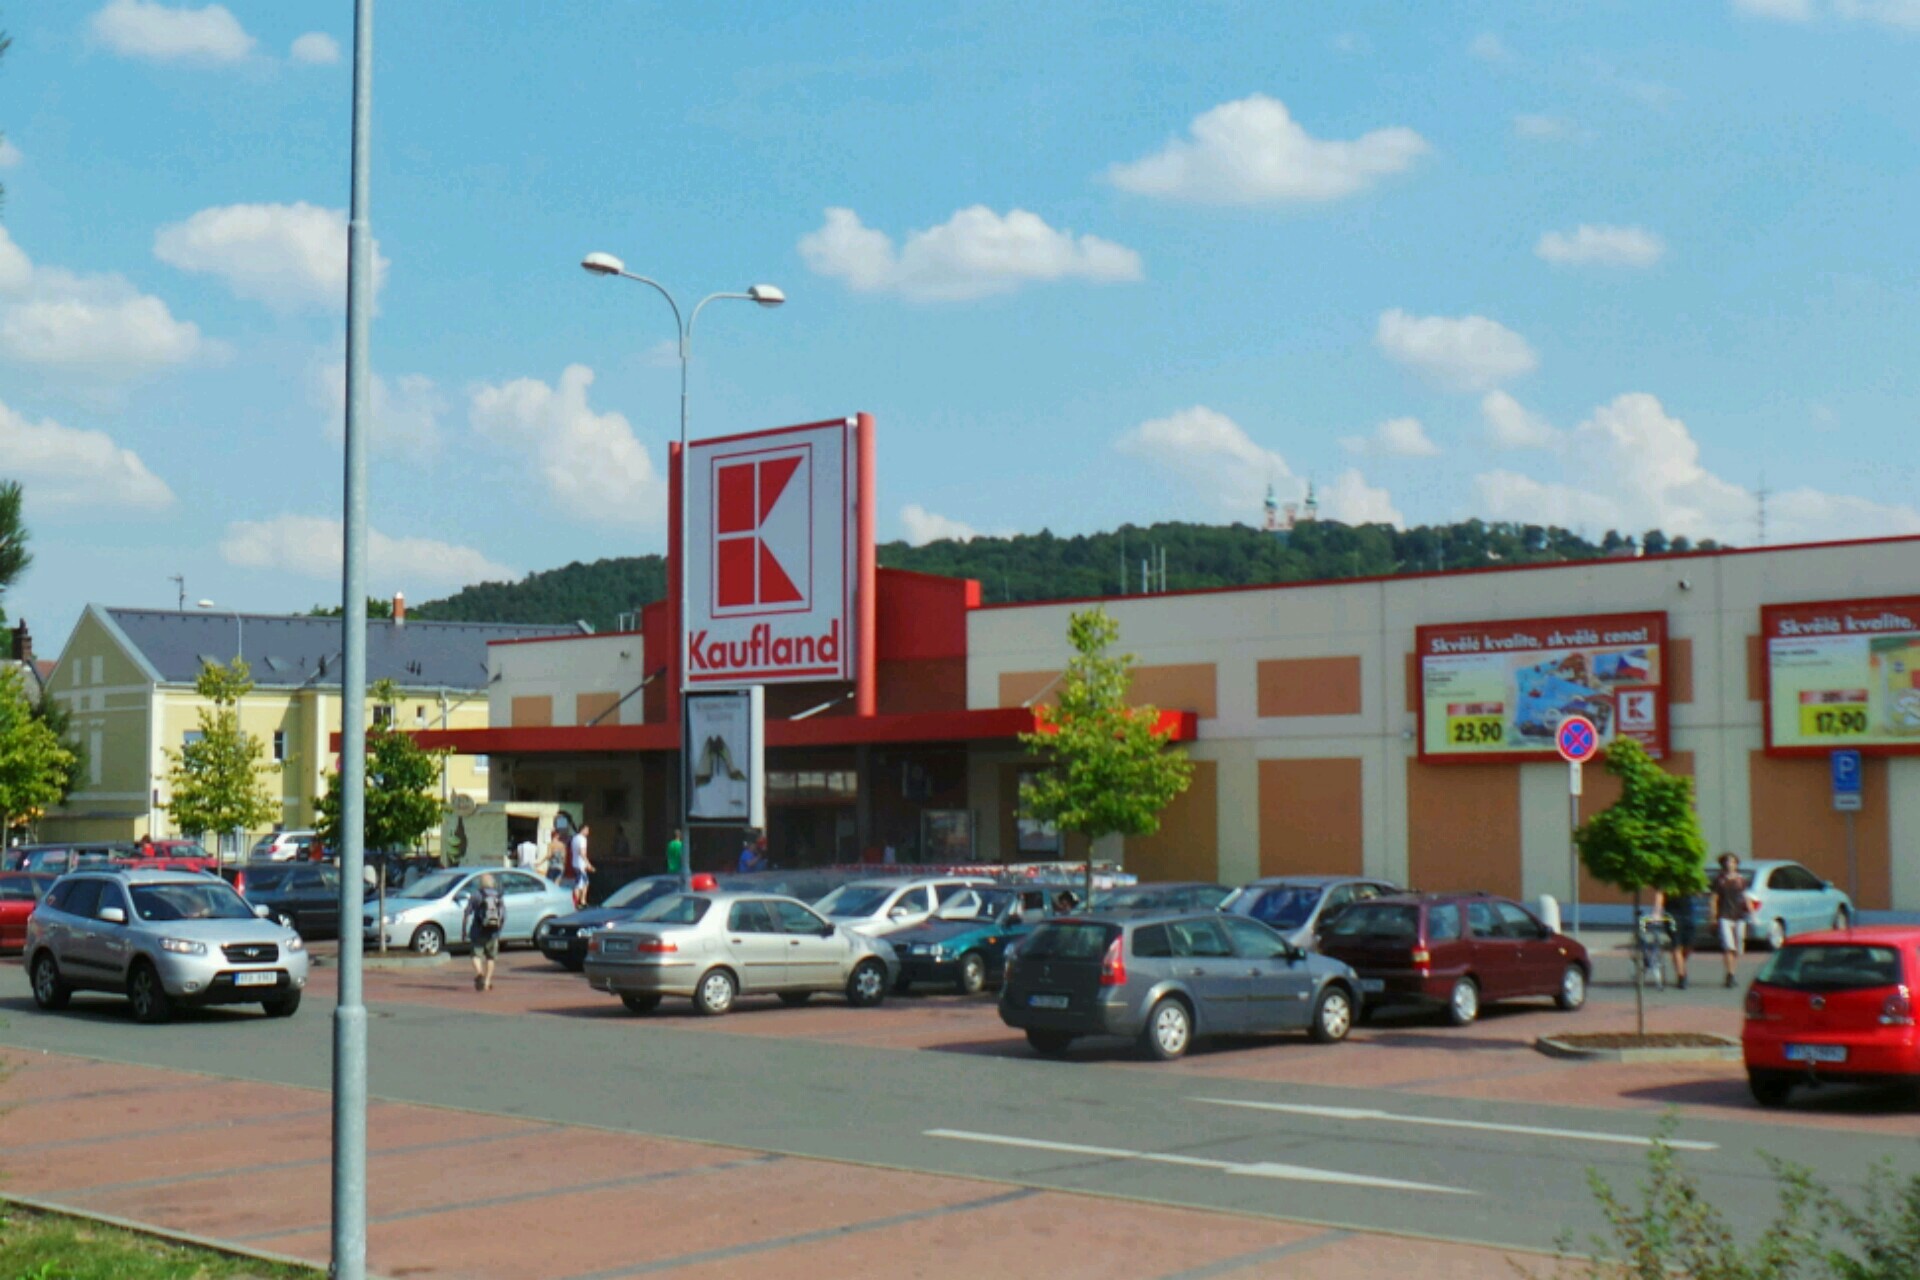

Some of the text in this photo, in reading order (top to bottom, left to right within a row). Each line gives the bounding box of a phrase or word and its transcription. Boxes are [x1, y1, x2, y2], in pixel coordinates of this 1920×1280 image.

[689, 618, 839, 670] Kaufland
[1604, 626, 1648, 643] cena!
[1454, 721, 1503, 744] 23,90
[1816, 711, 1867, 734] 17,90
[1838, 756, 1856, 780] P
